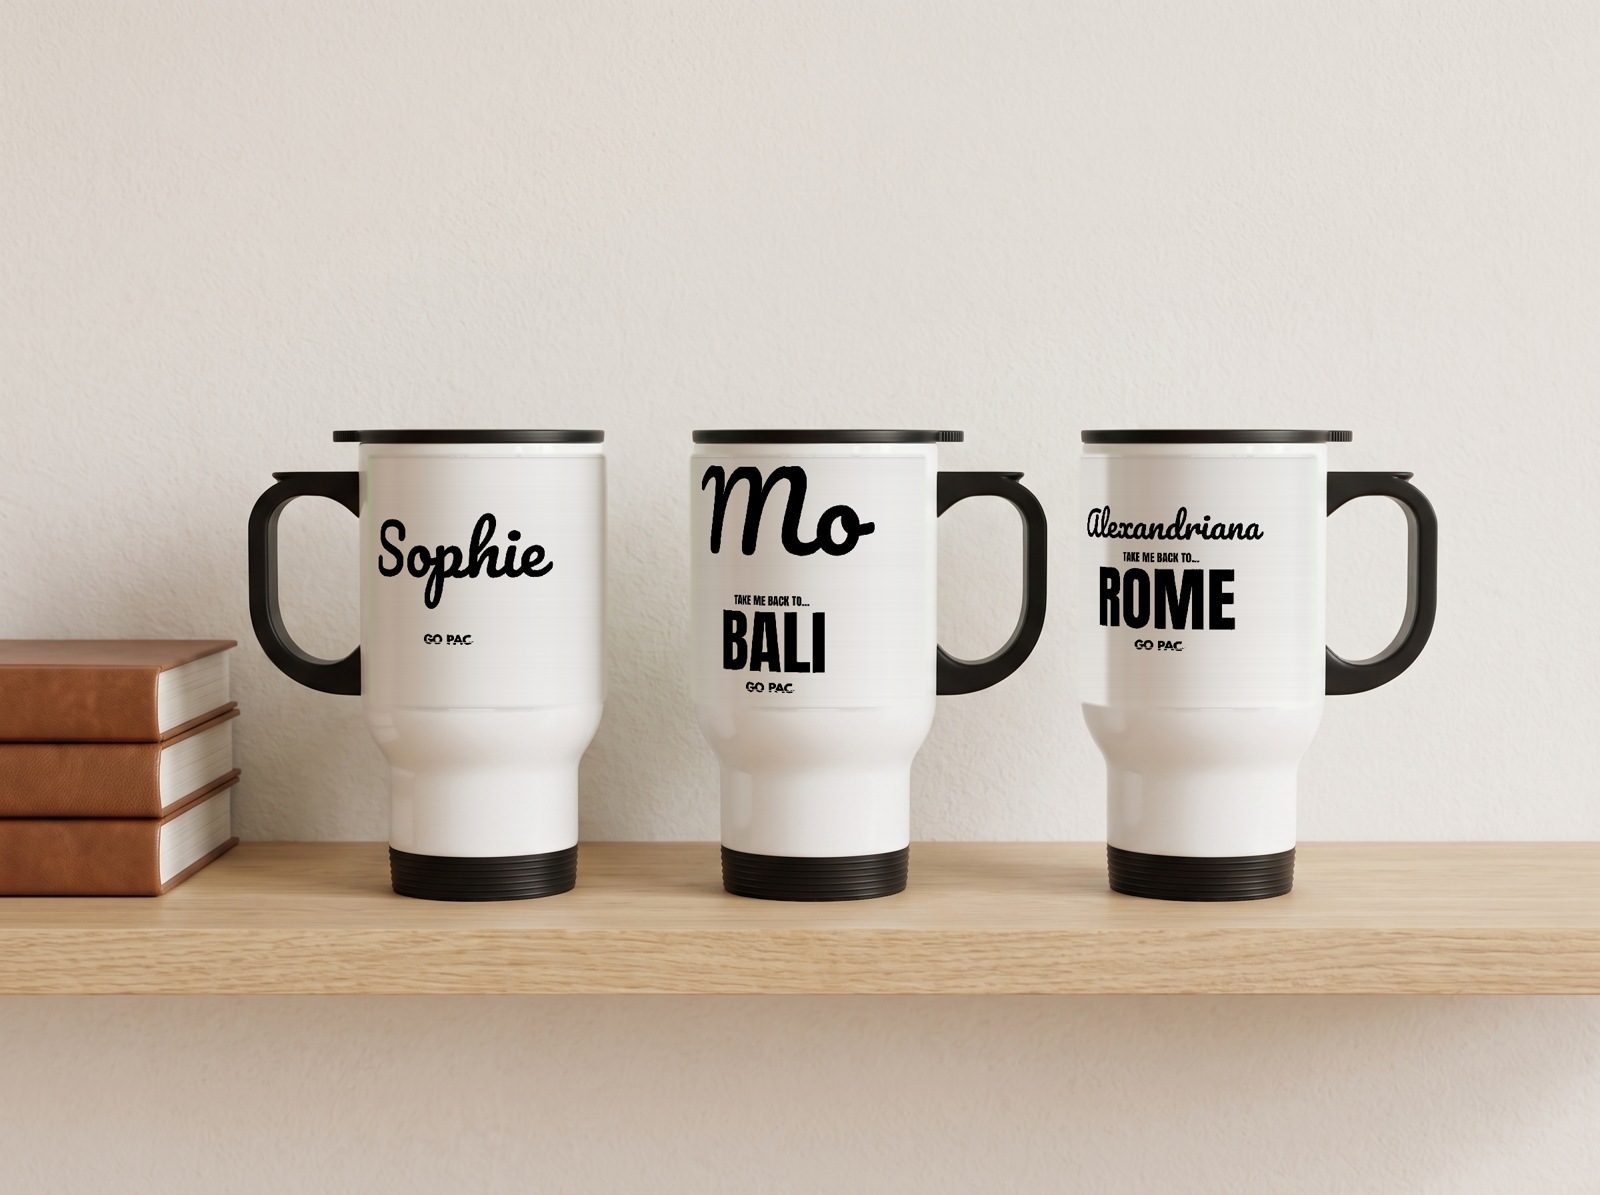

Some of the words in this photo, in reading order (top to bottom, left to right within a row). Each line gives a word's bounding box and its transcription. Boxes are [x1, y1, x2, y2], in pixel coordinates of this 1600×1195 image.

[702, 465, 875, 556] Mo
[1087, 505, 1264, 541] Alexandriana
[378, 513, 553, 609] Sophie
[1123, 552, 1140, 562] TAKE
[1142, 552, 1155, 563] ME
[1157, 553, 1178, 563] BACK
[1181, 553, 1200, 563] TO...
[734, 595, 751, 605] TAKE
[753, 595, 766, 606] ME
[768, 596, 789, 606] BACK
[792, 596, 810, 606] TO...
[1100, 567, 1235, 630] ROME
[424, 634, 442, 644] GO
[723, 609, 825, 673] BALI
[1134, 639, 1154, 650] GO
[745, 681, 764, 692] GO
